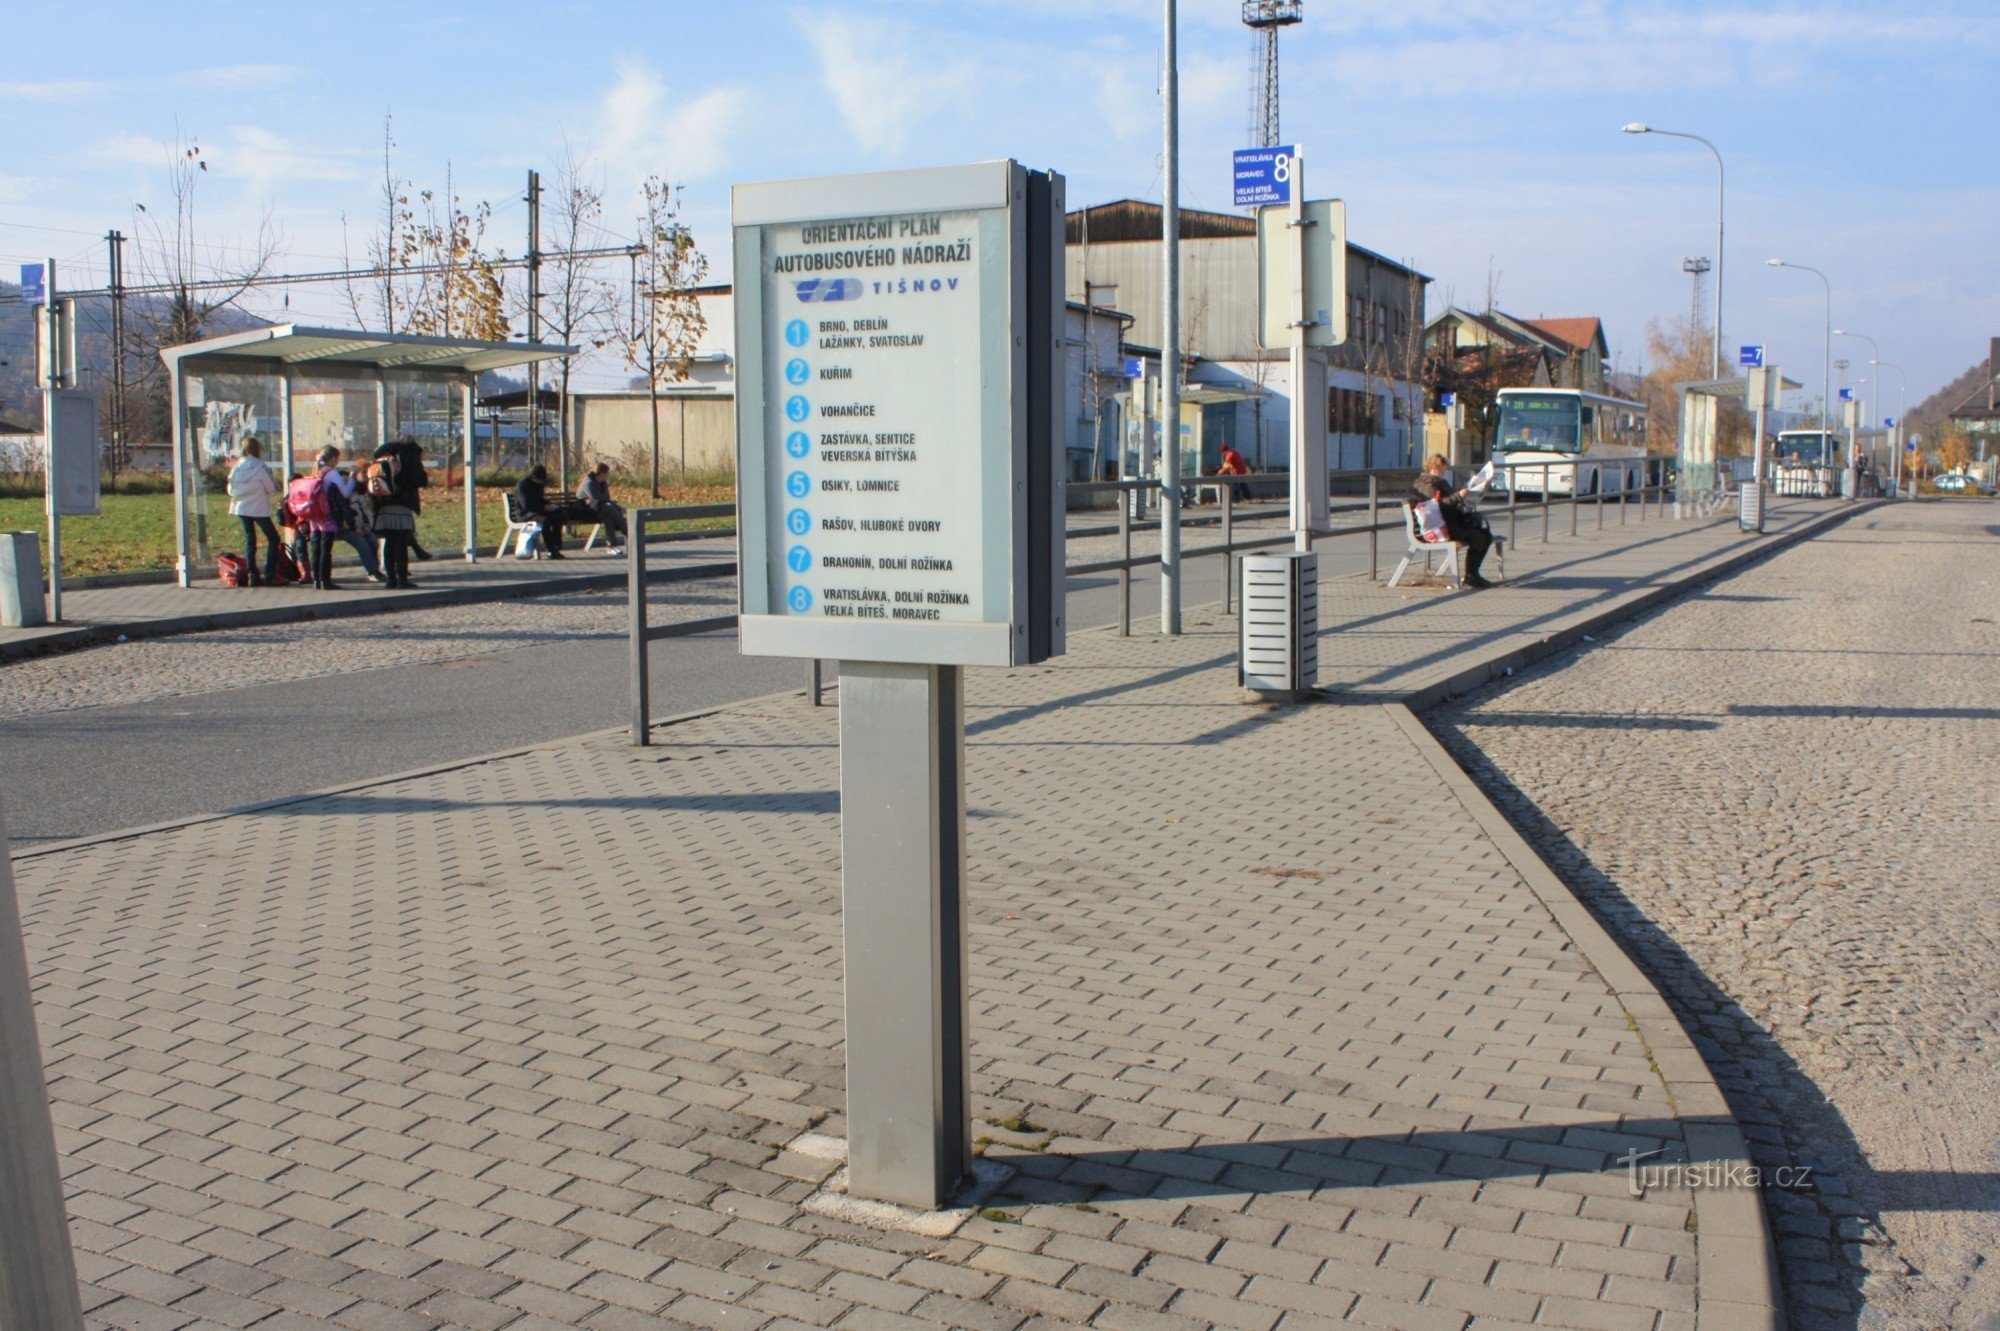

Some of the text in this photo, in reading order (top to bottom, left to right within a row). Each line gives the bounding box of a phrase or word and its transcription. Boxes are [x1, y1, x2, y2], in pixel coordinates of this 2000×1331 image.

[1235, 154, 1273, 163] VRATISLÁVKA
[1274, 153, 1289, 182] 8
[1236, 185, 1272, 195] VELKÁ BÍTEŠ
[1236, 195, 1254, 203] DOLNÍ
[774, 238, 972, 273] AUTOBUSOVÉHO NÁDRAŽÍ
[873, 277, 959, 294] TIŠNOV
[819, 320, 849, 333] BRNO,
[853, 316, 888, 331] DEBLÍN
[819, 334, 924, 350] LAŽÁNKY, SVATOSLAV
[1755, 348, 1762, 360] 7
[792, 358, 852, 384] 2 KUŘIM
[792, 396, 875, 421] 3 VOHANČICE
[791, 431, 916, 456] 4 ZASTÁVKA, SENTICE
[821, 447, 917, 462] VEVERSKÁ BÍTÝŠKA
[792, 472, 900, 497] 5 OSIKY, LOMNICE
[793, 509, 941, 534] 6 RAŠOV, HLUBOKÉ DVORY
[793, 548, 953, 571] 7 DRAHONÍN, DOLNÍ ROŽÍNKA
[794, 586, 970, 612] 8 VRATISLÁVKA, DOLNÍ ROŽÍNKA
[824, 603, 854, 617] VELKÁ
[892, 608, 940, 621] MORAVEC
